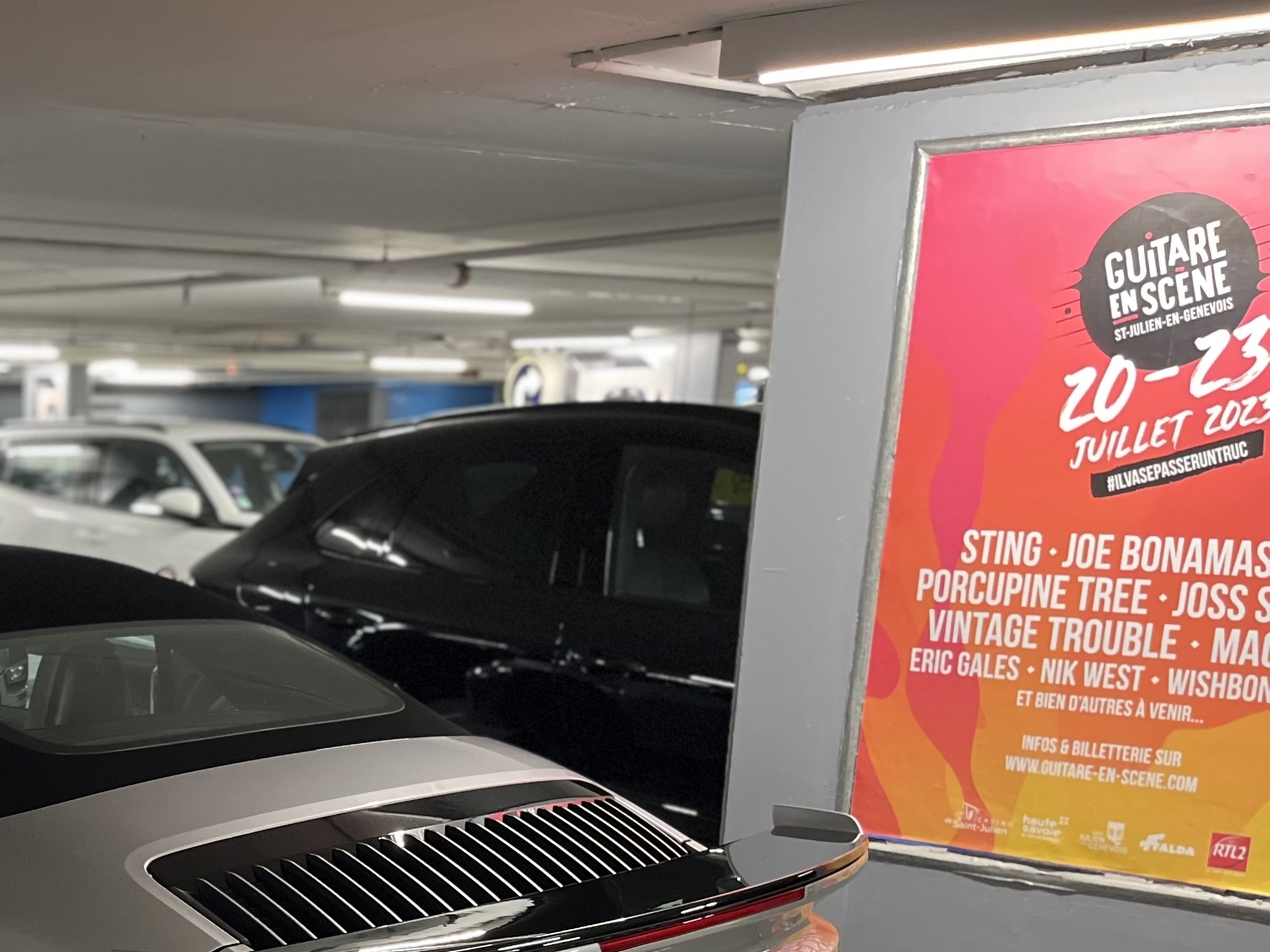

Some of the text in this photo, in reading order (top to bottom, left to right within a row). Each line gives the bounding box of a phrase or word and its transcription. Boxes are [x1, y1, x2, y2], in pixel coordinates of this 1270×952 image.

[1109, 289, 1138, 319] EN
[1114, 297, 1234, 341] ST-JULIEN-EN-GENEVOIS
[1059, 355, 1136, 432] 20
[1190, 315, 1270, 398] 23
[1069, 391, 1270, 469] JUILLET 2023
[1107, 441, 1248, 492] #ILVASEPASSERUNTRUC
[961, 529, 1043, 567] STING
[1061, 533, 1115, 570] JOE
[916, 568, 1070, 609] PORCUPINE
[1077, 576, 1151, 615] TREE
[1171, 581, 1248, 621] JOSS
[929, 609, 1041, 649] VINTAGE
[1048, 617, 1181, 660] TROUBLE
[909, 647, 953, 675] ERIC
[957, 652, 1020, 680] GALES
[1040, 658, 1078, 686] NIK
[1083, 661, 1145, 691] WEST
[1016, 690, 1033, 707] ET
[1035, 692, 1066, 711] BIEN
[1135, 698, 1145, 718] À
[1149, 702, 1204, 724] VENIR...
[1022, 735, 1182, 767] INFOS & BILLETTERIE SUR
[1005, 755, 1198, 793] WWW.GUITARE-EN-SCENE.COM
[952, 819, 1008, 836] Saint-Julien
[1212, 843, 1247, 861] RTL2
